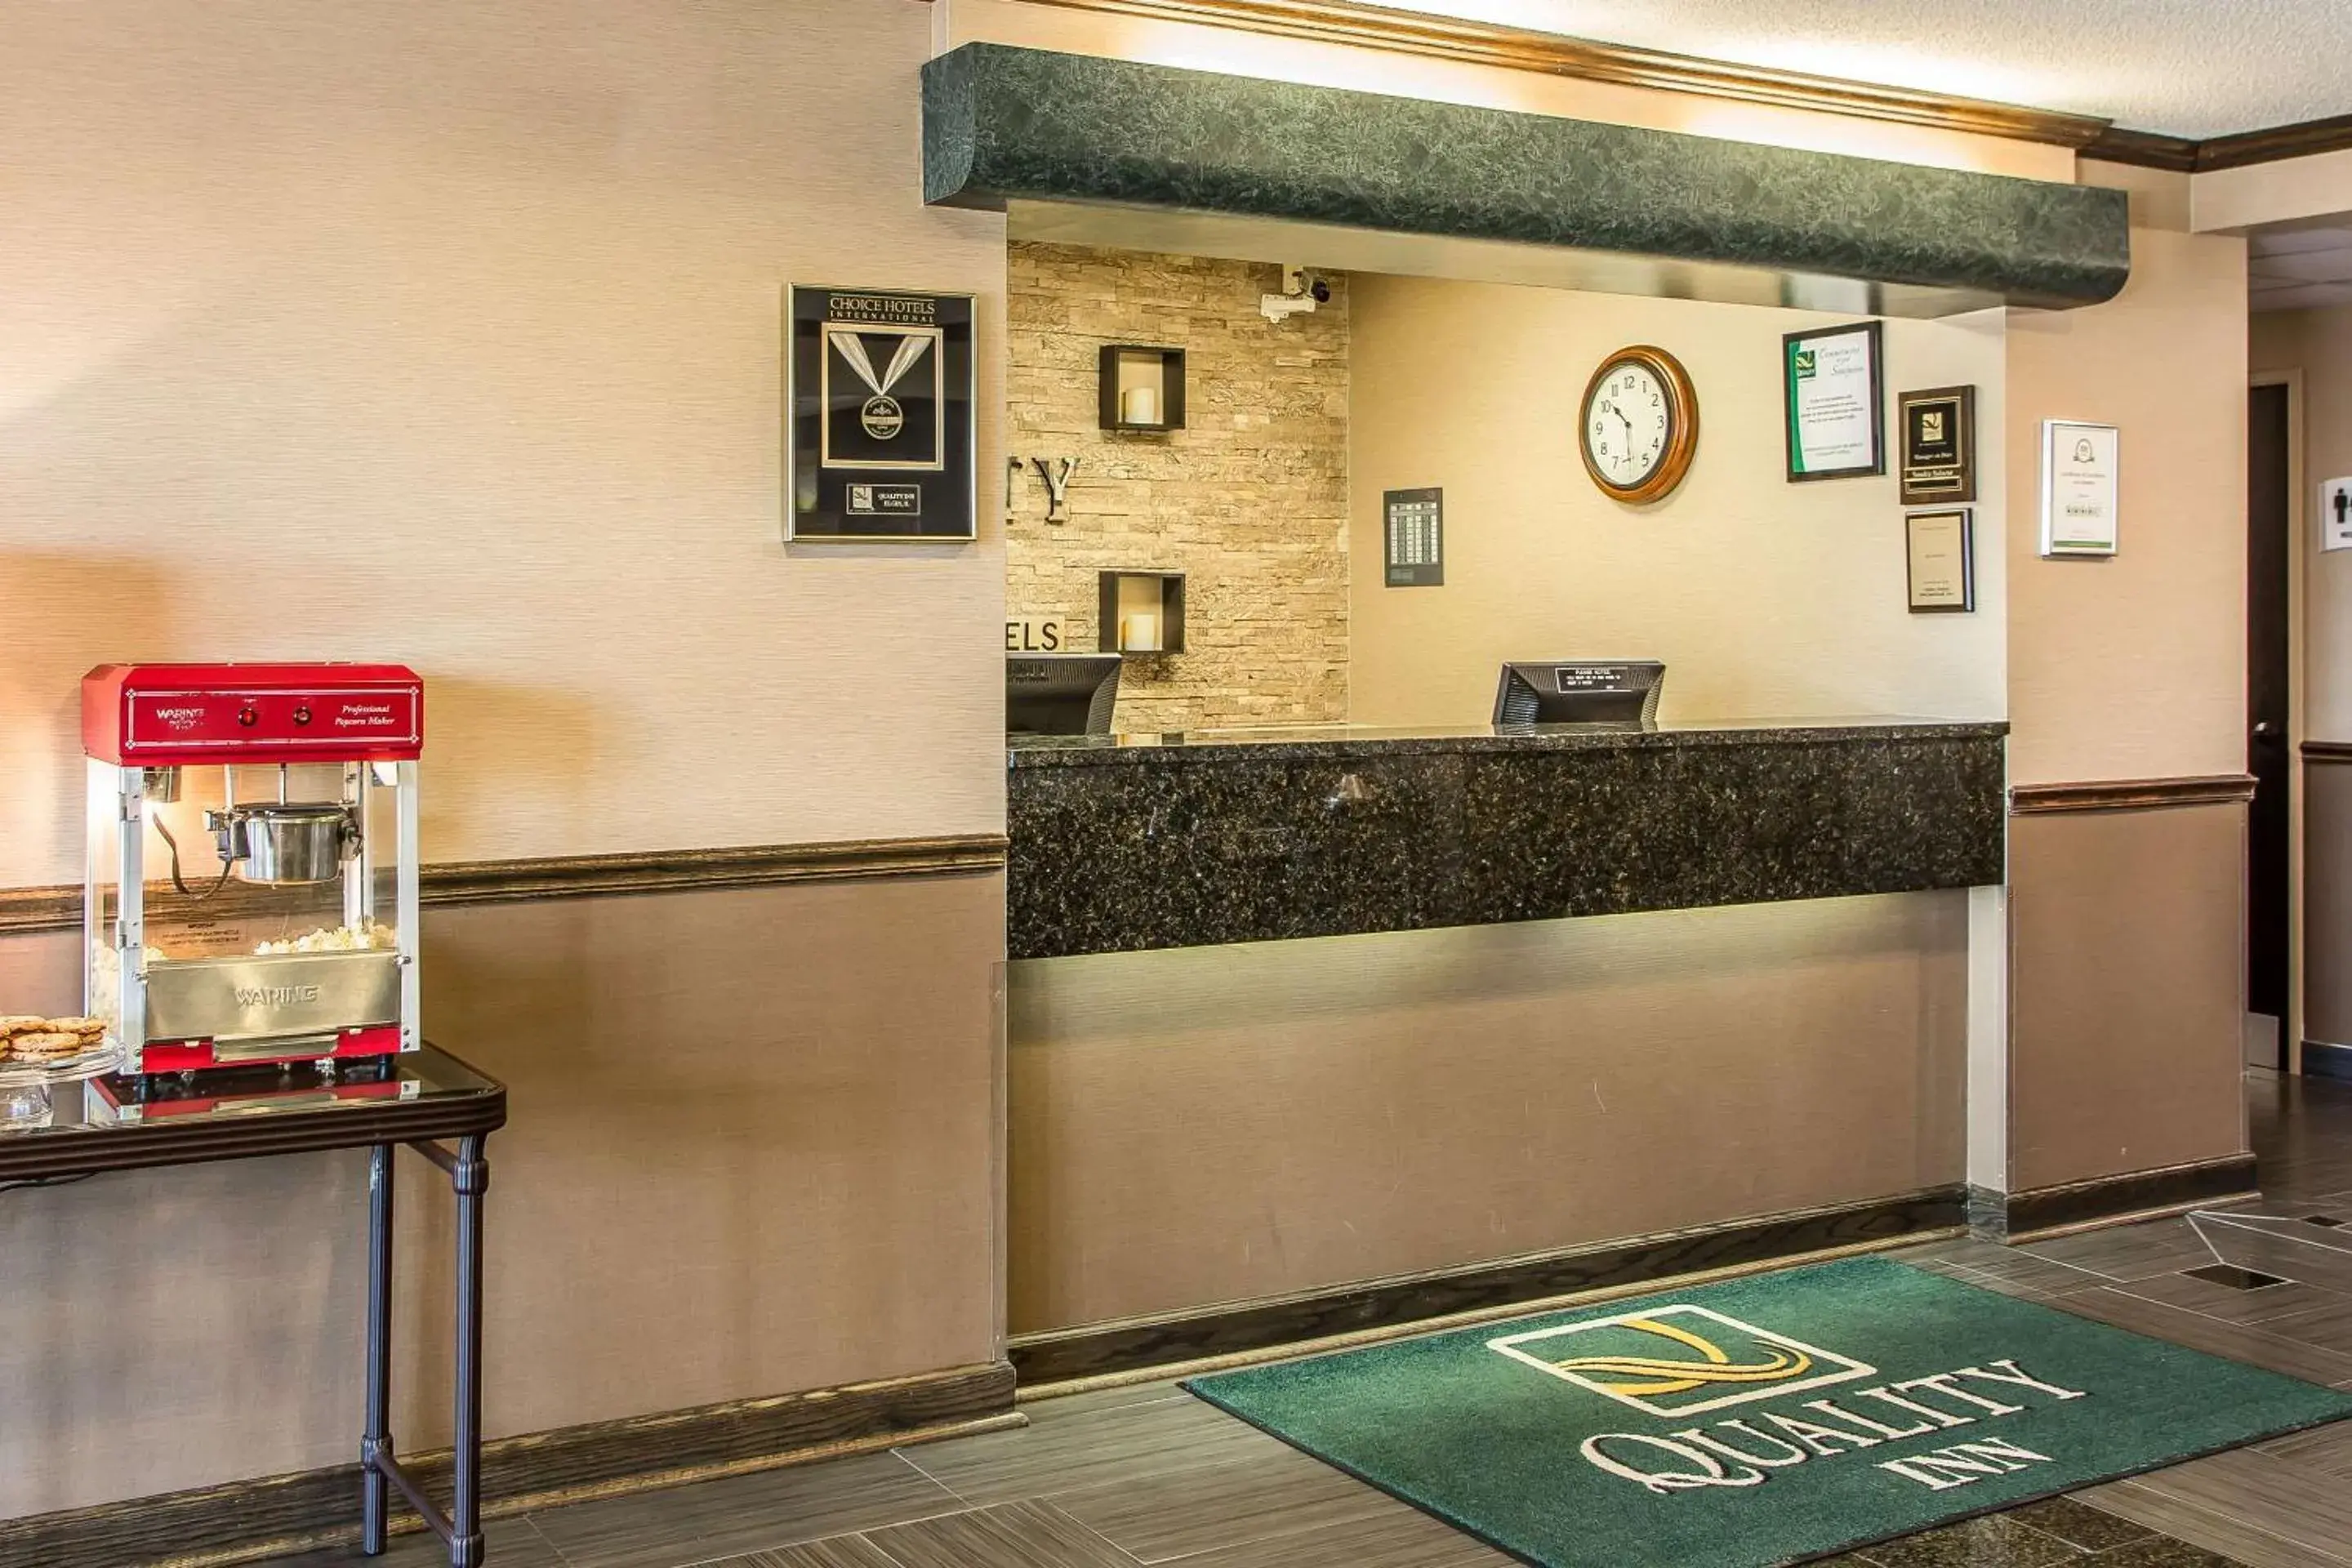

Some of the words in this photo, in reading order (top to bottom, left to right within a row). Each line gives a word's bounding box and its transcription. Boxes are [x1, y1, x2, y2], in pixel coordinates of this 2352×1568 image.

[830, 297, 882, 311] CHOICE
[884, 301, 935, 314] HOTELS
[830, 310, 933, 323] INTERNATIONAL
[1624, 376, 1635, 390] 12
[1642, 381, 1647, 393] 1
[1611, 384, 1619, 397] 11
[1601, 400, 1611, 413] 10
[1651, 394, 1659, 407] 2
[1596, 421, 1603, 434] 9
[1657, 415, 1664, 429] 3
[1601, 442, 1607, 455] 8
[1652, 437, 1659, 450] 4
[1612, 457, 1619, 470] 7
[1642, 453, 1649, 467] 5
[1006, 622, 1058, 651] ELS
[342, 705, 390, 715] Professional
[335, 717, 366, 728] Popcorn
[235, 985, 320, 1008] WARING
[1581, 1359, 2087, 1494] QUALITY
[1873, 1437, 2054, 1490] INN
